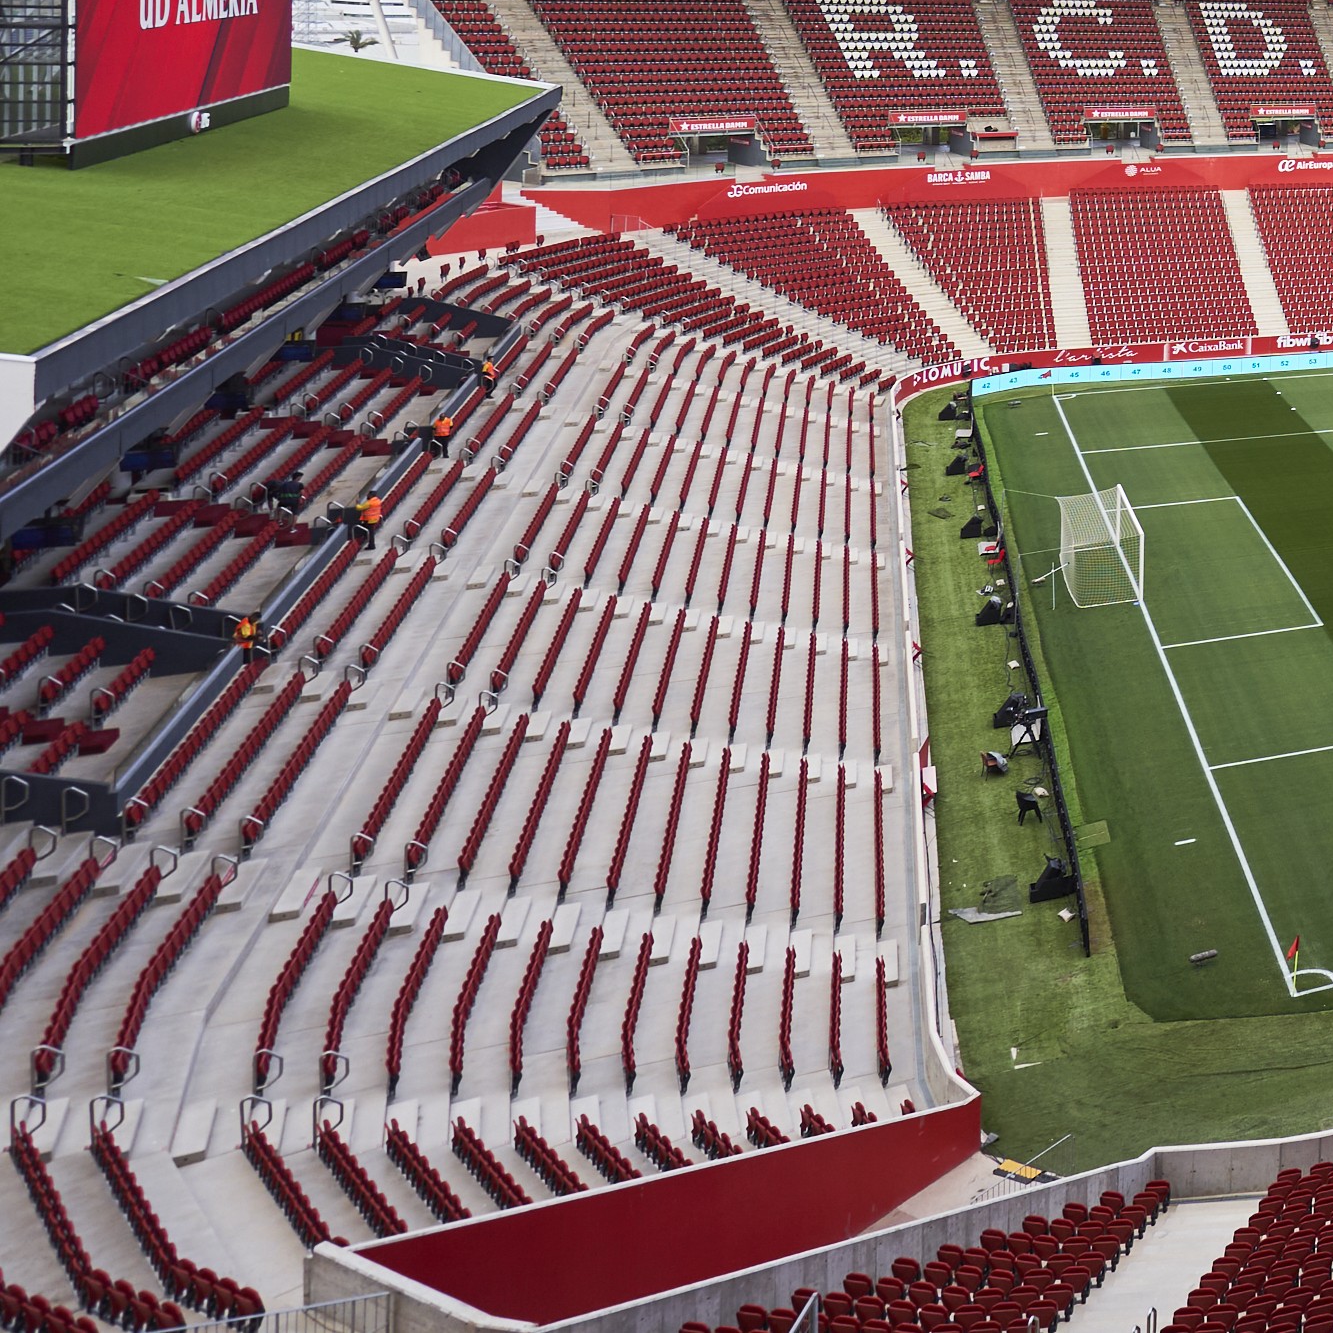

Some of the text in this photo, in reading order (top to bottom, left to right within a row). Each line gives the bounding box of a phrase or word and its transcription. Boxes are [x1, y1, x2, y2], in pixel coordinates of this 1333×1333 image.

[938, 114, 959, 122] DAMM
[690, 121, 748, 130] ESTRELLA DAMM
[965, 171, 990, 180] SAMBA
[1188, 340, 1244, 353] CaixaBank
